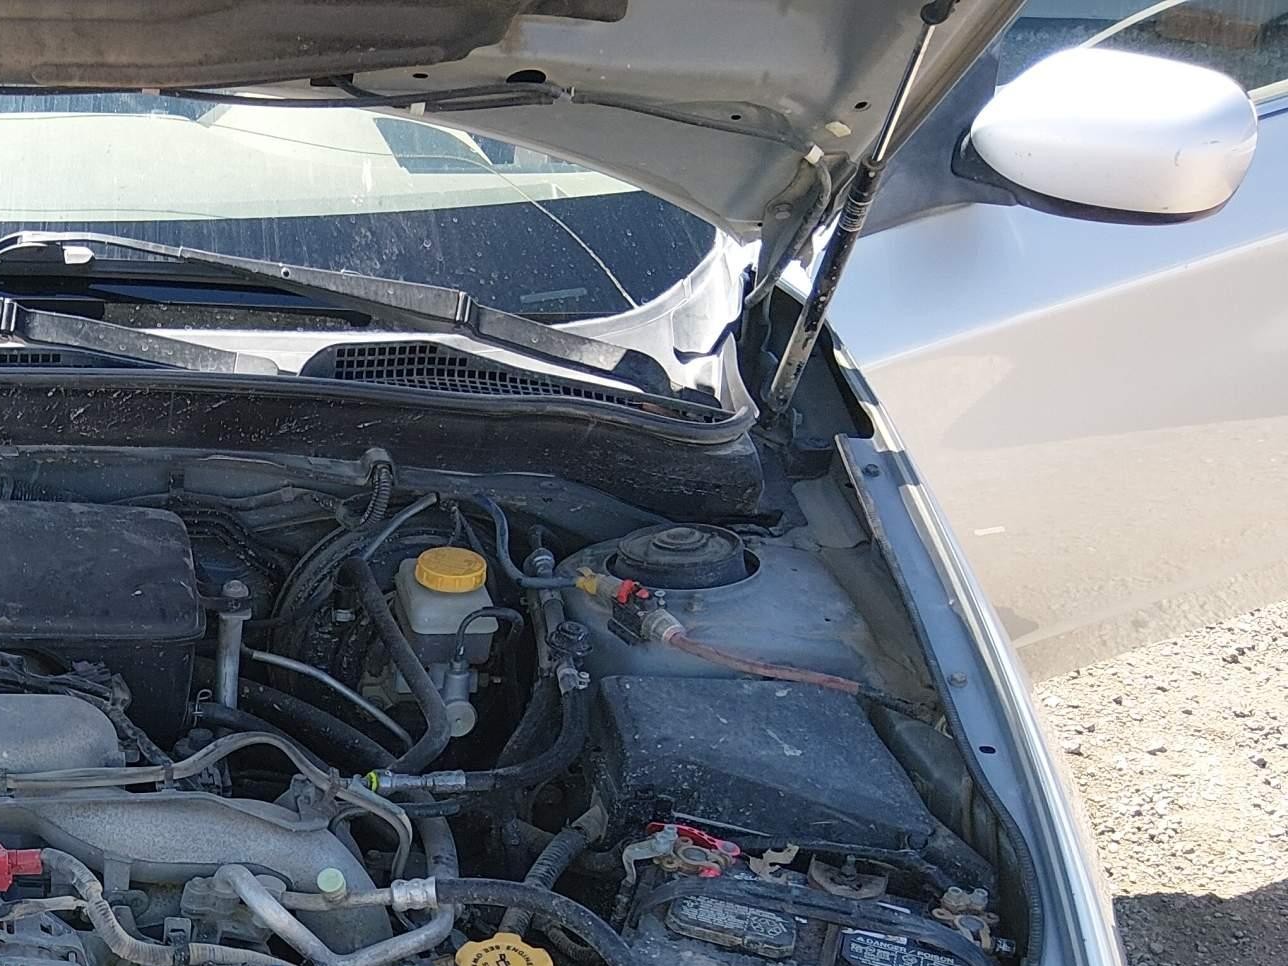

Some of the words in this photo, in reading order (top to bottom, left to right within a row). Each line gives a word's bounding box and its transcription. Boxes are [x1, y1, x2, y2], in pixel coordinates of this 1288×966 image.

[482, 944, 500, 954] SEE
[505, 944, 534, 966] ENGINE
[866, 938, 907, 954] DANGER
[917, 950, 955, 965] POISON
